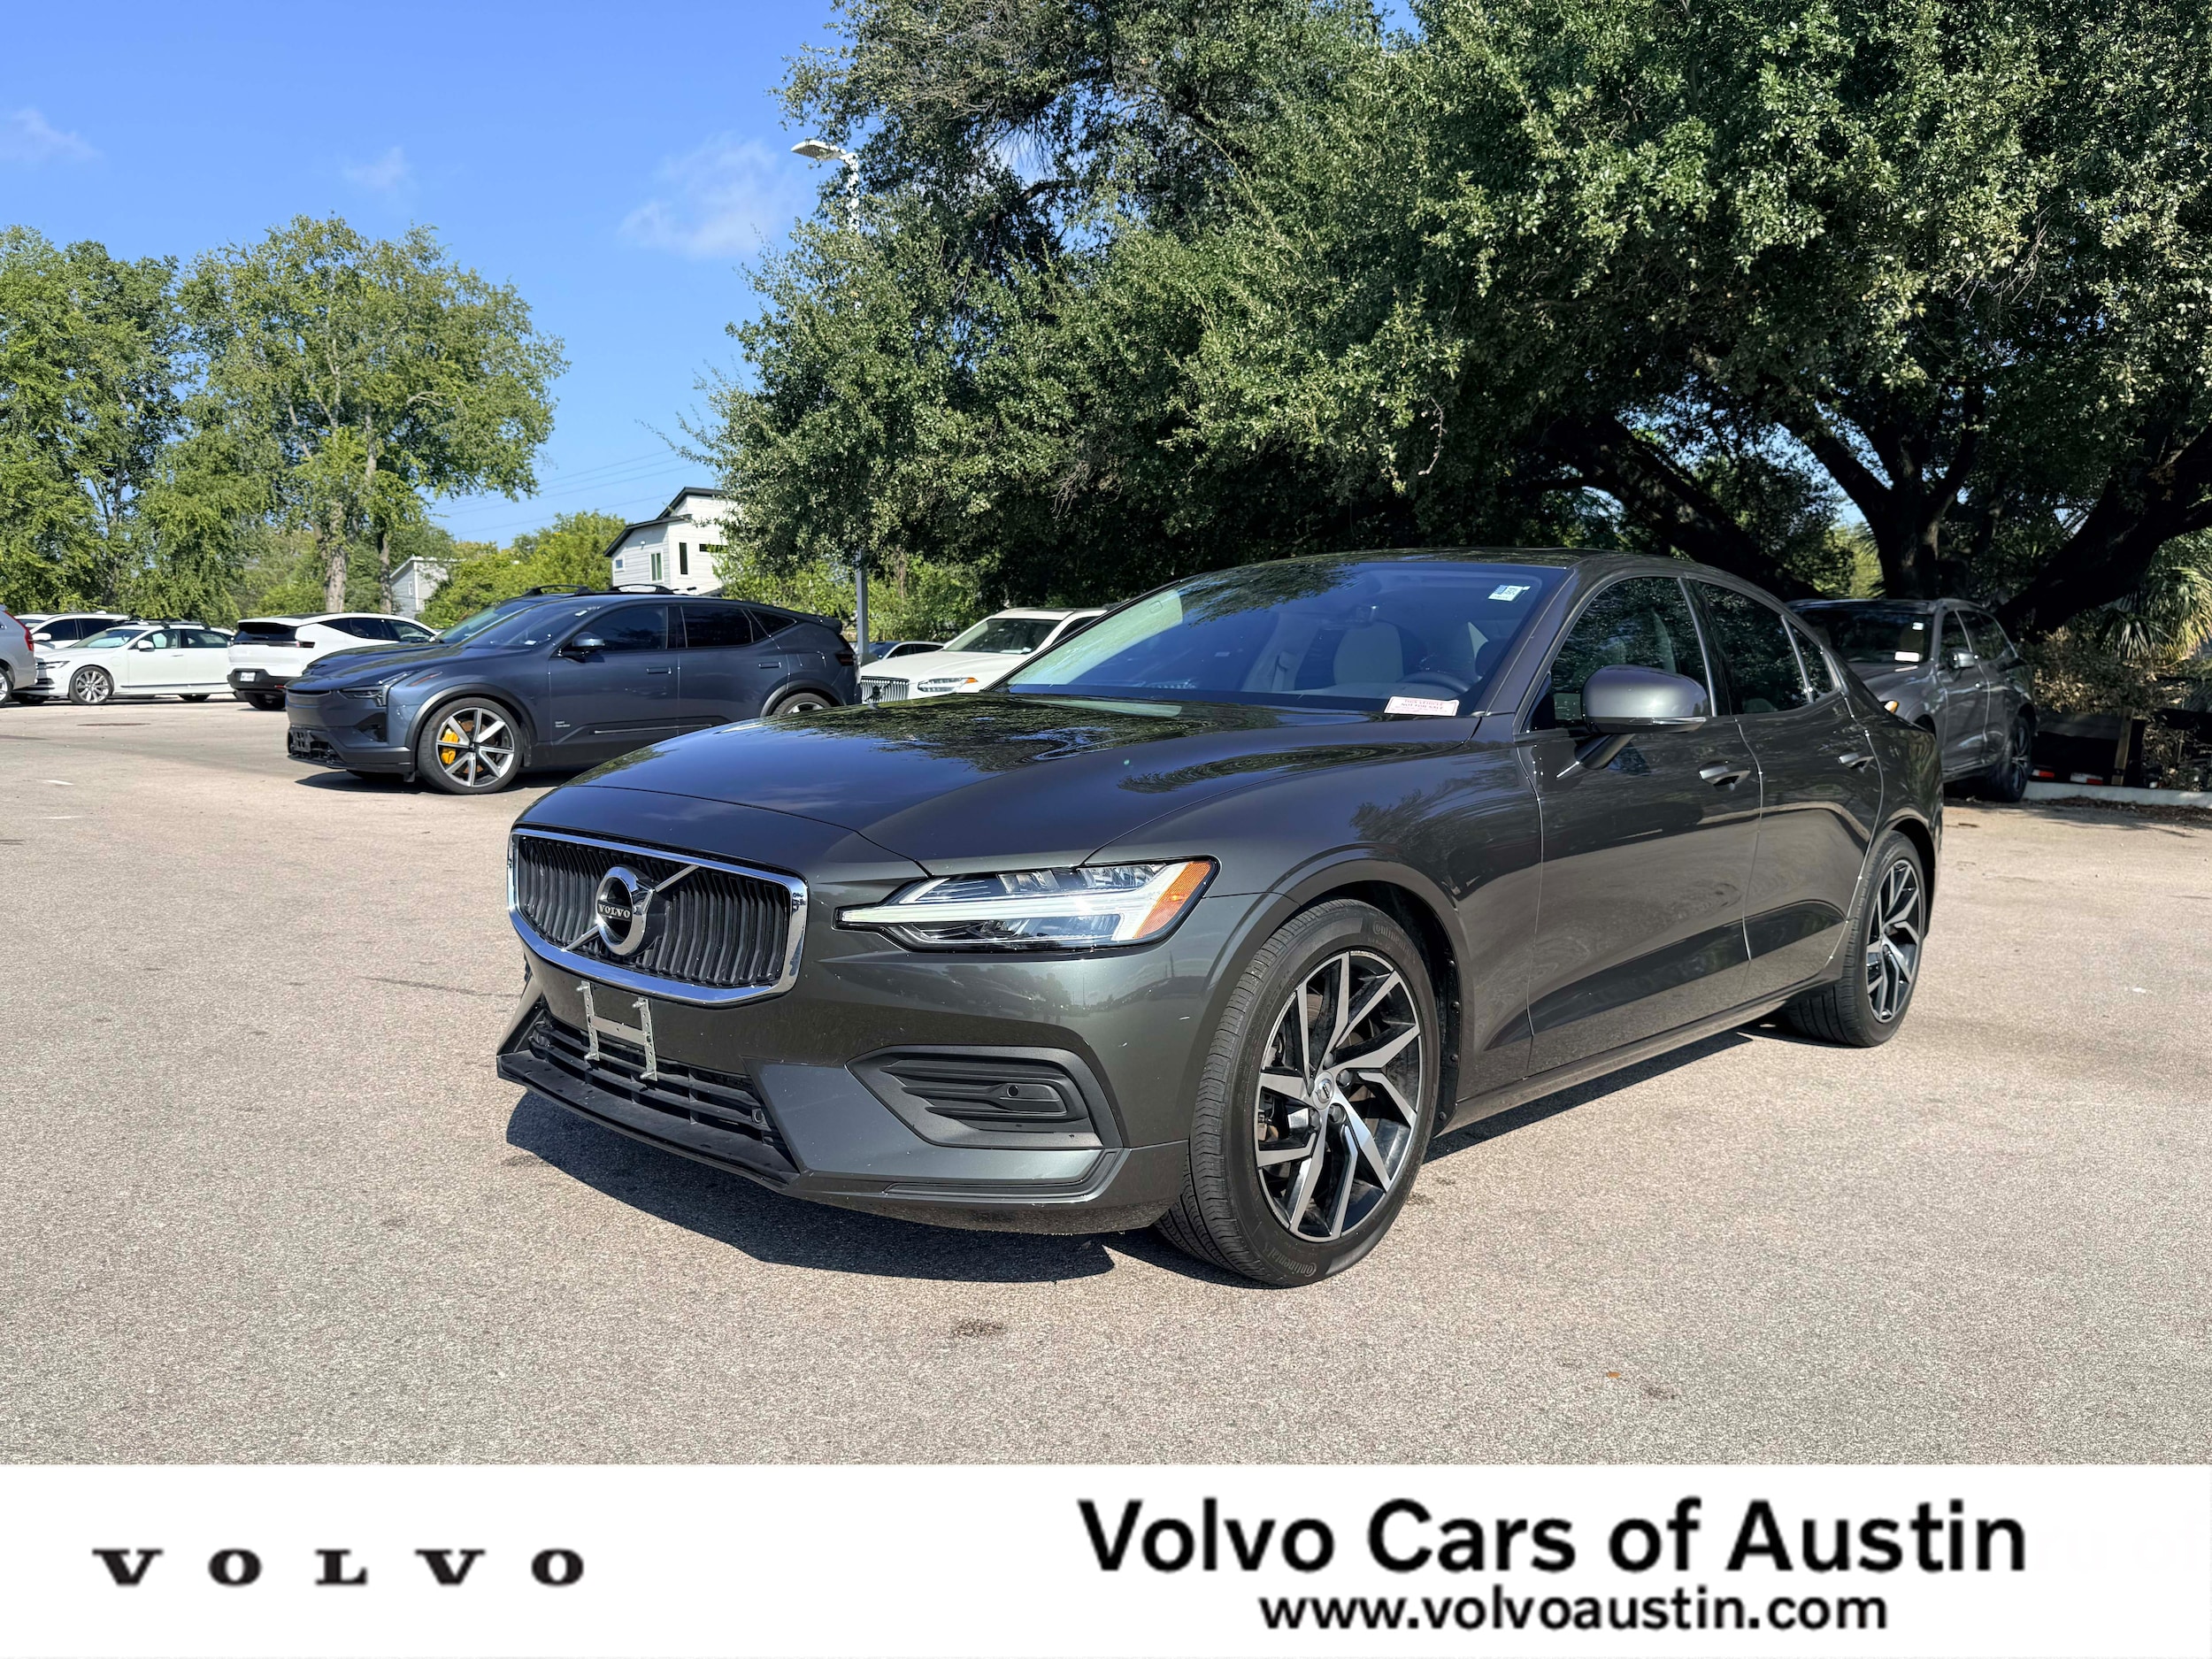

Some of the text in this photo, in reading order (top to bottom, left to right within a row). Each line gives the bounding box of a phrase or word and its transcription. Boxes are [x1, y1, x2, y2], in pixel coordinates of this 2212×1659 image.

[598, 903, 631, 918] VOLVO
[1372, 920, 1412, 959] Continental
[1267, 1248, 1317, 1277] Continental
